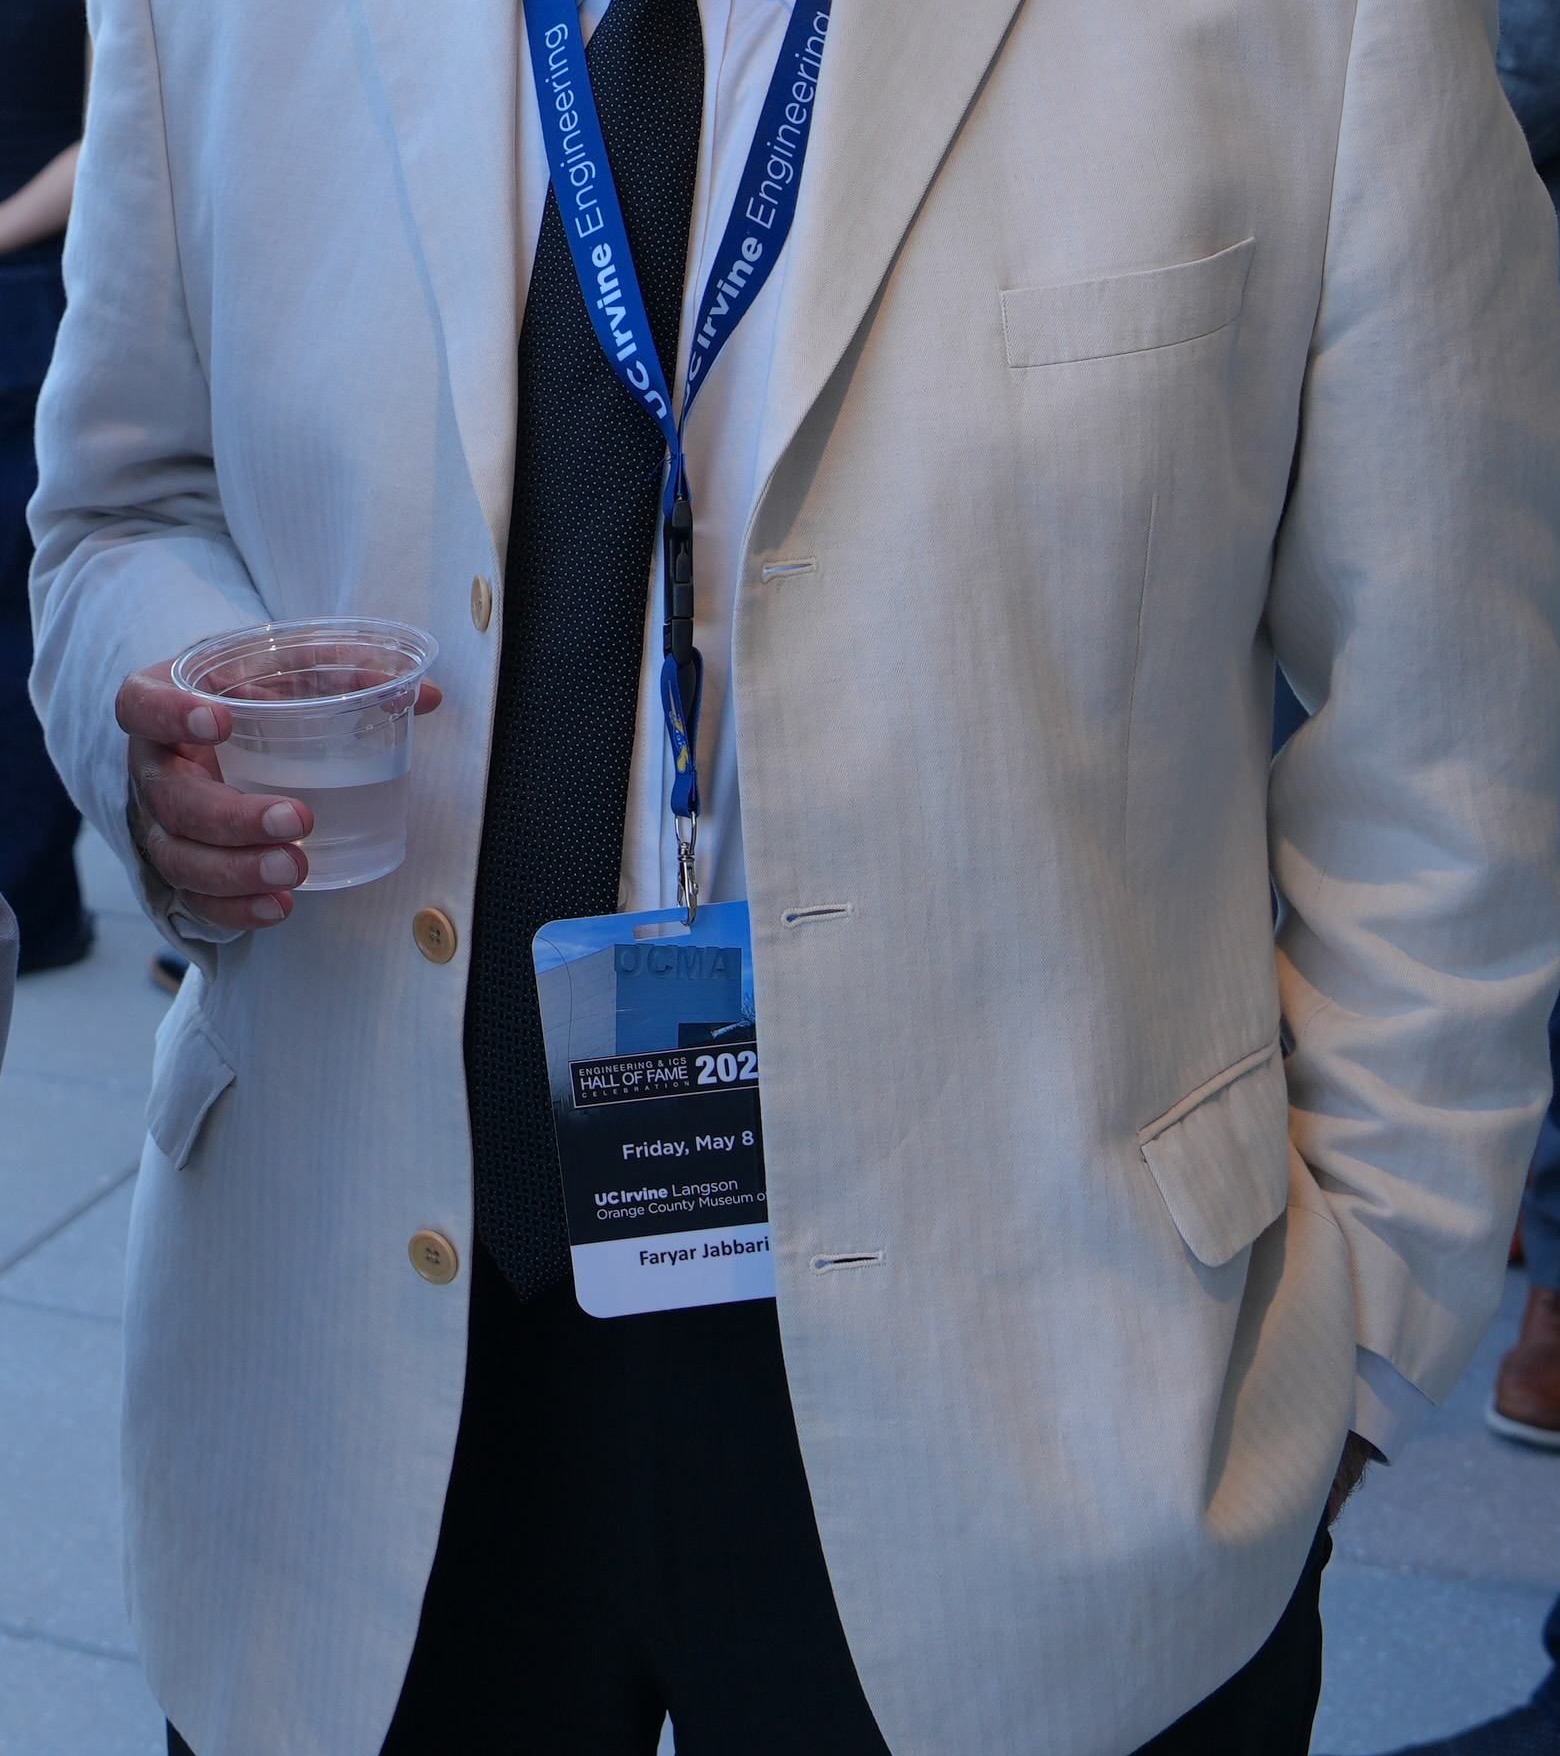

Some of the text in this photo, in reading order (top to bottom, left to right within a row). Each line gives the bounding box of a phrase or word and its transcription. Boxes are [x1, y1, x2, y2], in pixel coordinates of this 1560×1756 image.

[696, 236, 764, 347] Irvine
[746, 10, 831, 230] Engineering
[544, 22, 668, 420] UC Irvine Engineering
[618, 943, 736, 980] OCMA
[579, 1057, 687, 1077] ENGINEERING & ICS
[580, 1066, 689, 1091] HALL OF FAME
[581, 1080, 690, 1099] CELEBRATION
[622, 1130, 754, 1160] Friday, May 8
[594, 1180, 739, 1206] UC Irvine Langson
[596, 1192, 767, 1220] Orange County Museum o
[639, 1236, 770, 1266] Faryar Jabbari
